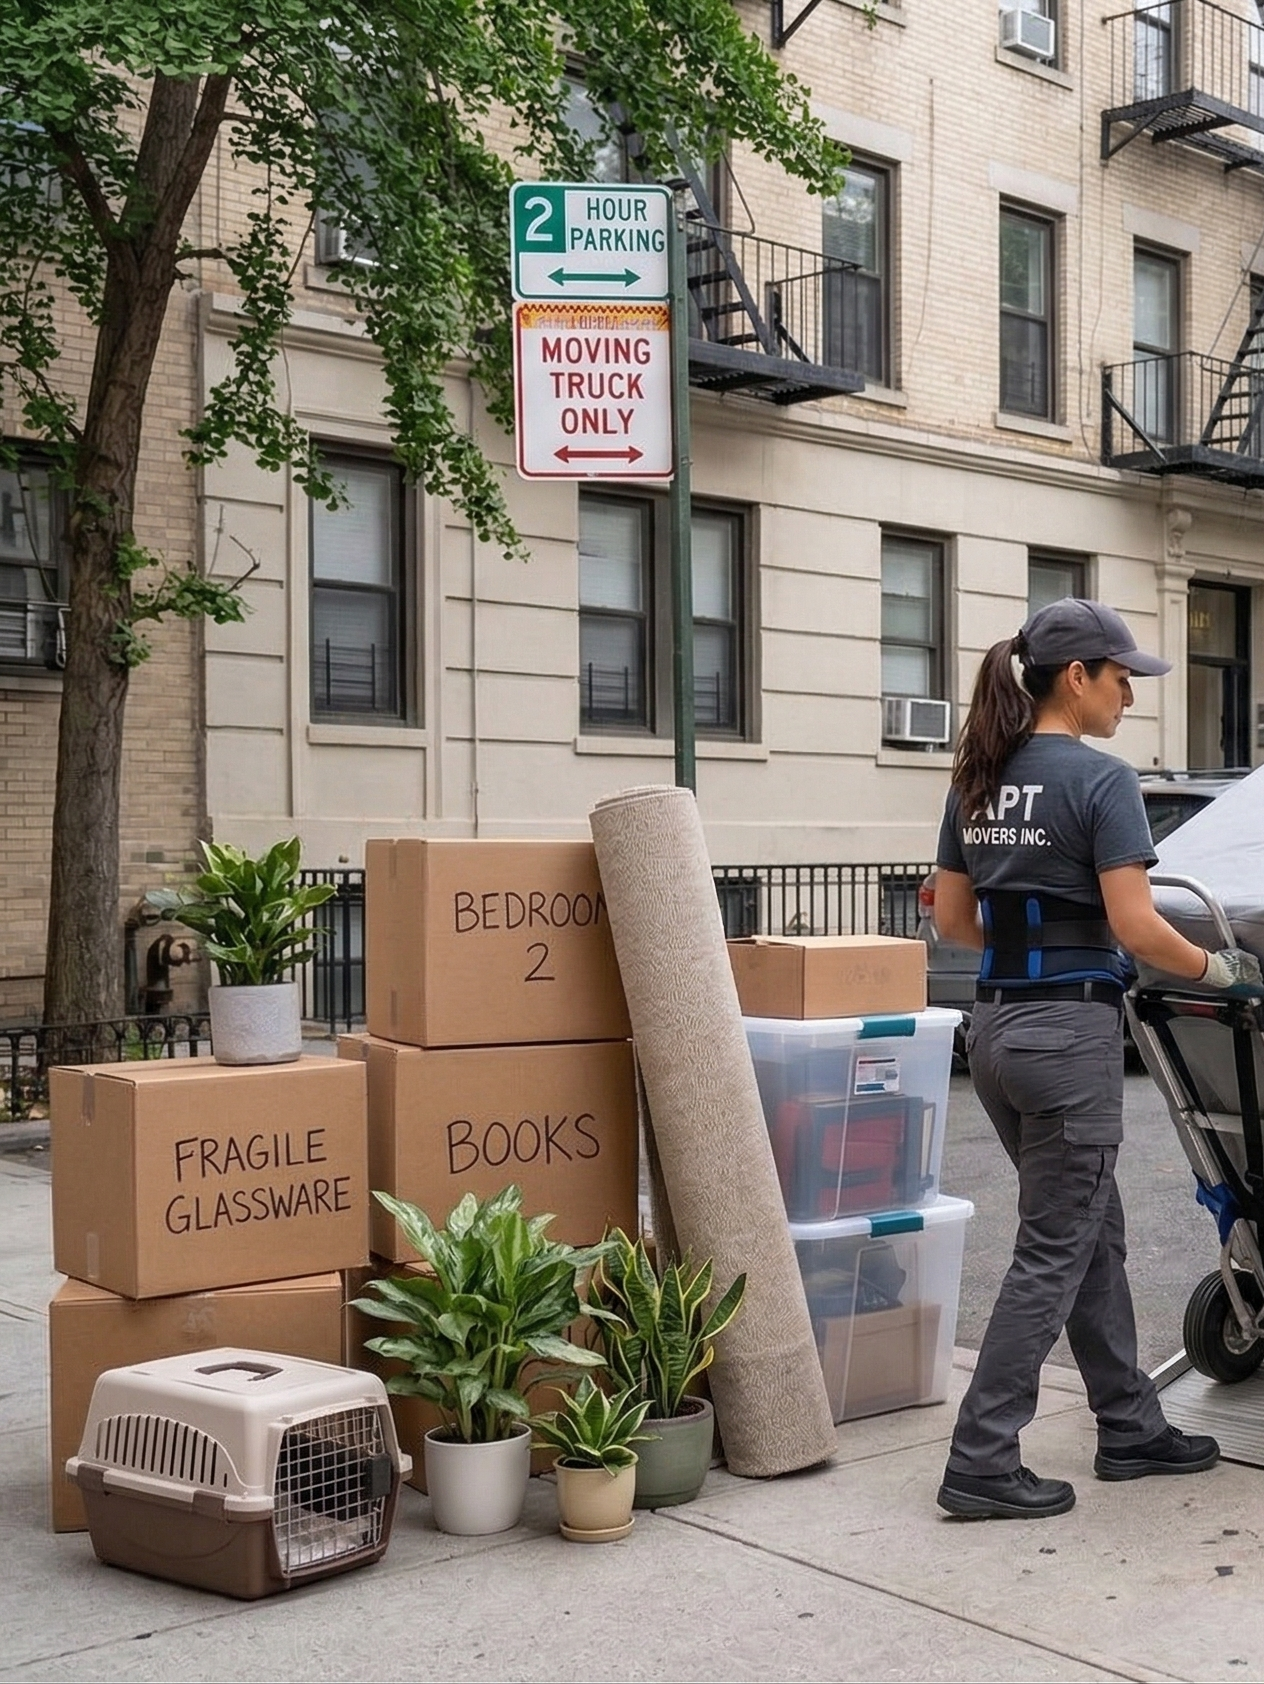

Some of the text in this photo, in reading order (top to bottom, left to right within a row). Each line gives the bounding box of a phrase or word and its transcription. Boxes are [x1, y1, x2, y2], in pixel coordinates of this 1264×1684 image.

[524, 196, 553, 241] 2
[587, 197, 647, 221] HOUR
[570, 227, 665, 253] PARKING
[541, 337, 651, 365] MOVING
[550, 372, 644, 399] TRUCK
[561, 408, 634, 435] ONLY
[962, 827, 1052, 847] MOVERS INC.
[524, 942, 555, 983] 2
[174, 1128, 328, 1183] FRAGILE
[446, 1113, 600, 1175] BOOKS
[165, 1176, 352, 1235] GLASSWARE
